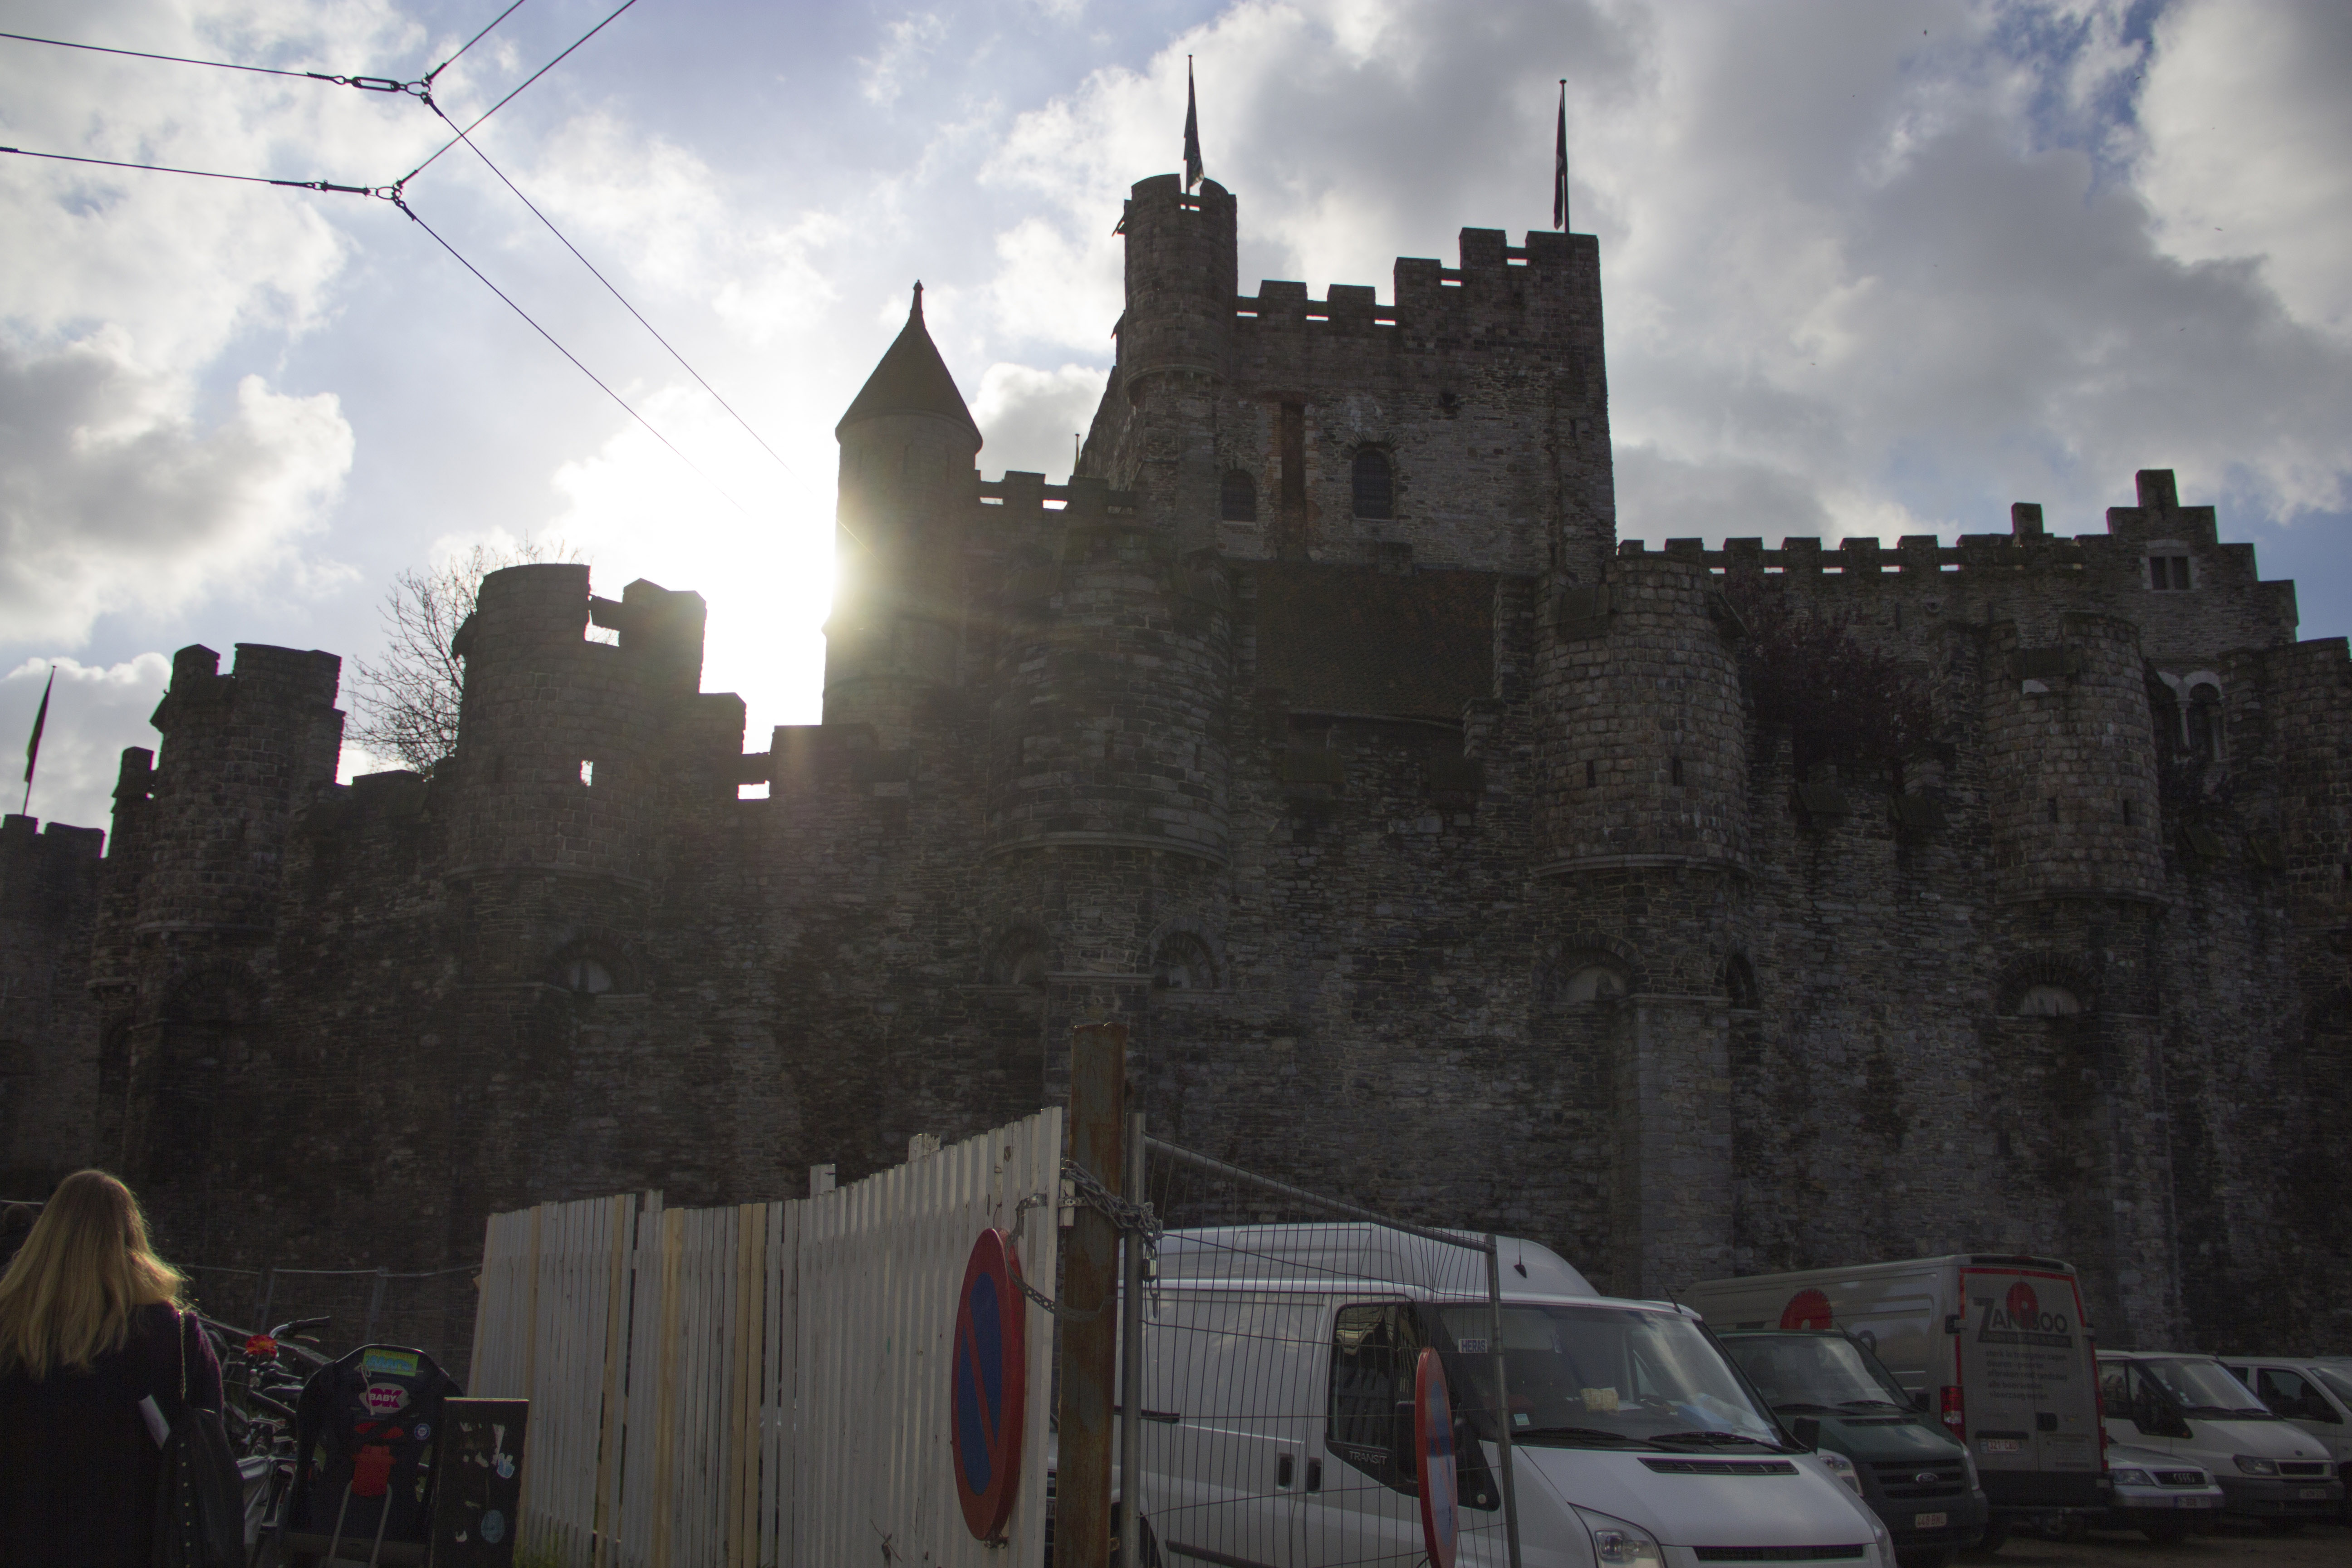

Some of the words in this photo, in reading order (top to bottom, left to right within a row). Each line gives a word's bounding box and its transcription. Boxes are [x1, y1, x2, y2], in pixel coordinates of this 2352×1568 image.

[1462, 1339, 1485, 1352] HERAS
[366, 1387, 404, 1408] OK
[369, 1393, 397, 1402] BABY
[1349, 1450, 1387, 1465] TRANSIT
